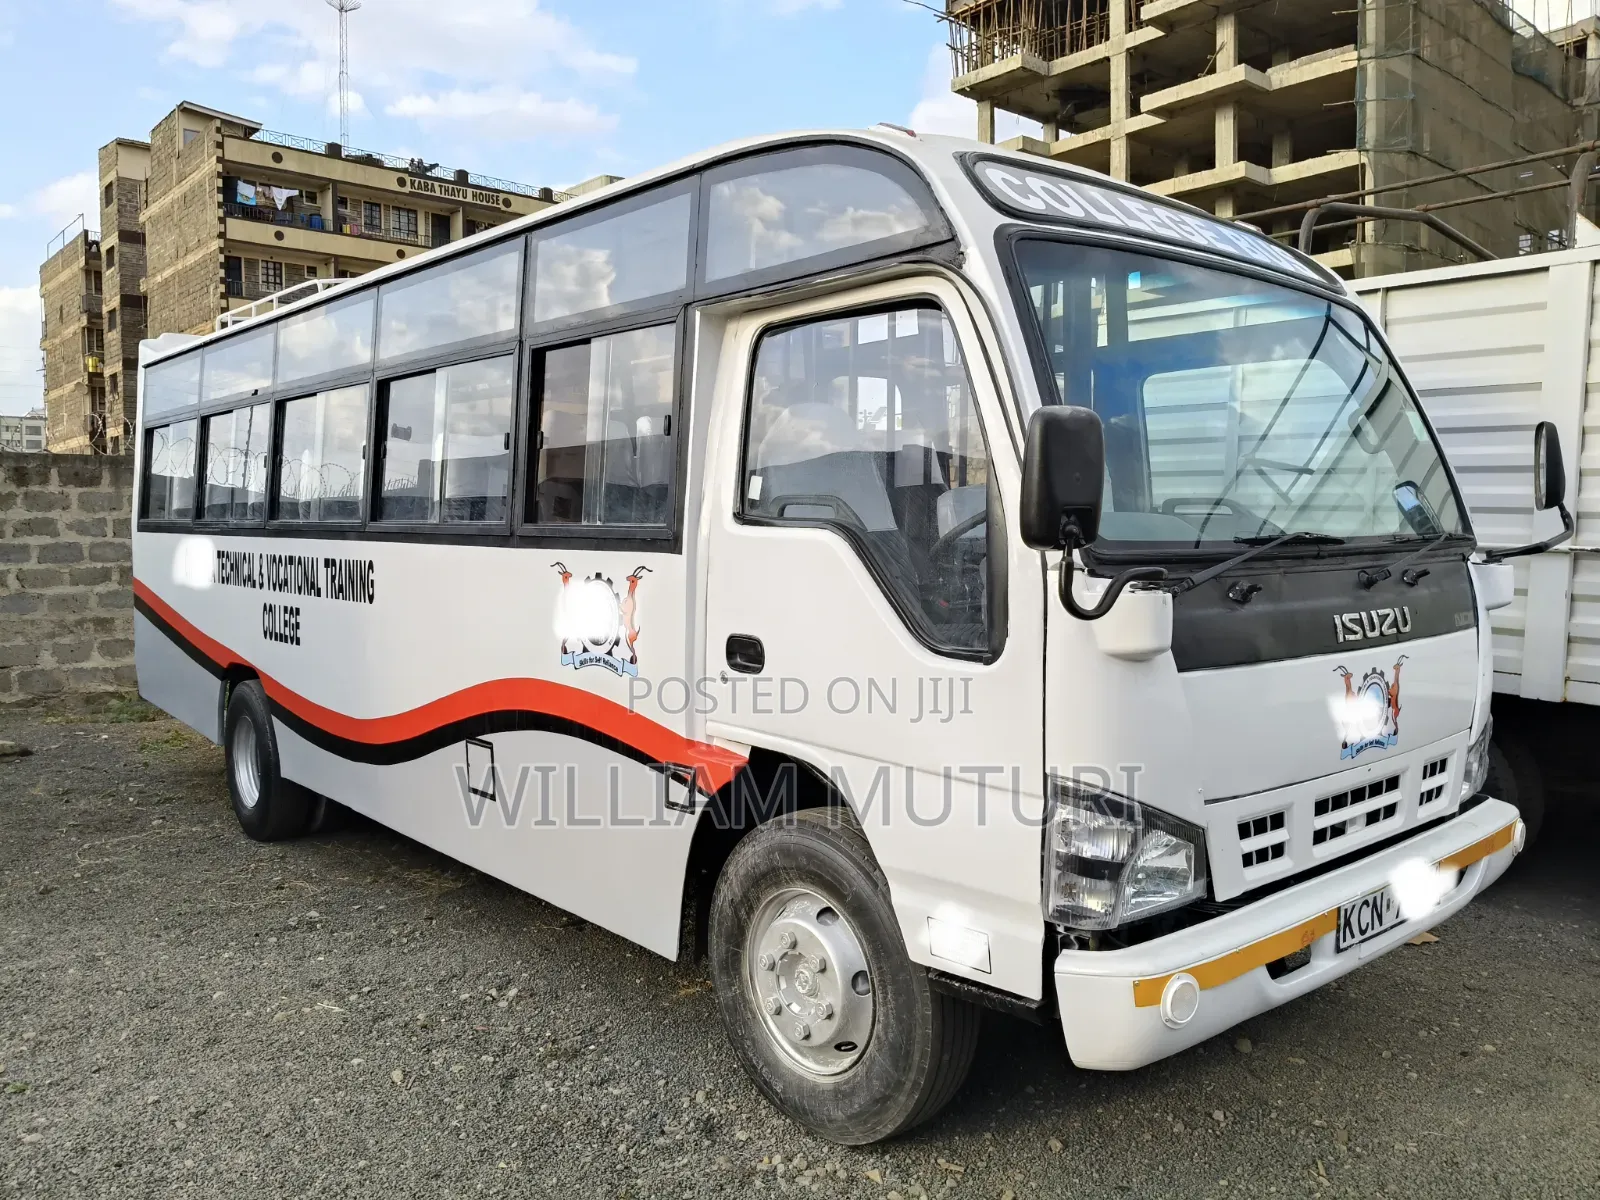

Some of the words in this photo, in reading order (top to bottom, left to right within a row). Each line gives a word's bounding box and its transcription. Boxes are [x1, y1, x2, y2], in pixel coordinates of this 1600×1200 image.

[409, 178, 436, 194] KABA
[438, 184, 468, 200] THAYU
[471, 191, 500, 206] HOUSE
[984, 168, 1240, 254] COLLEGE
[217, 550, 256, 589] TECHNICAL
[258, 553, 264, 590] &
[266, 554, 322, 598] VOCATIONAL
[324, 558, 375, 604] TRAINING
[262, 602, 301, 646] COLLEGE
[1333, 606, 1412, 644] ISUZU
